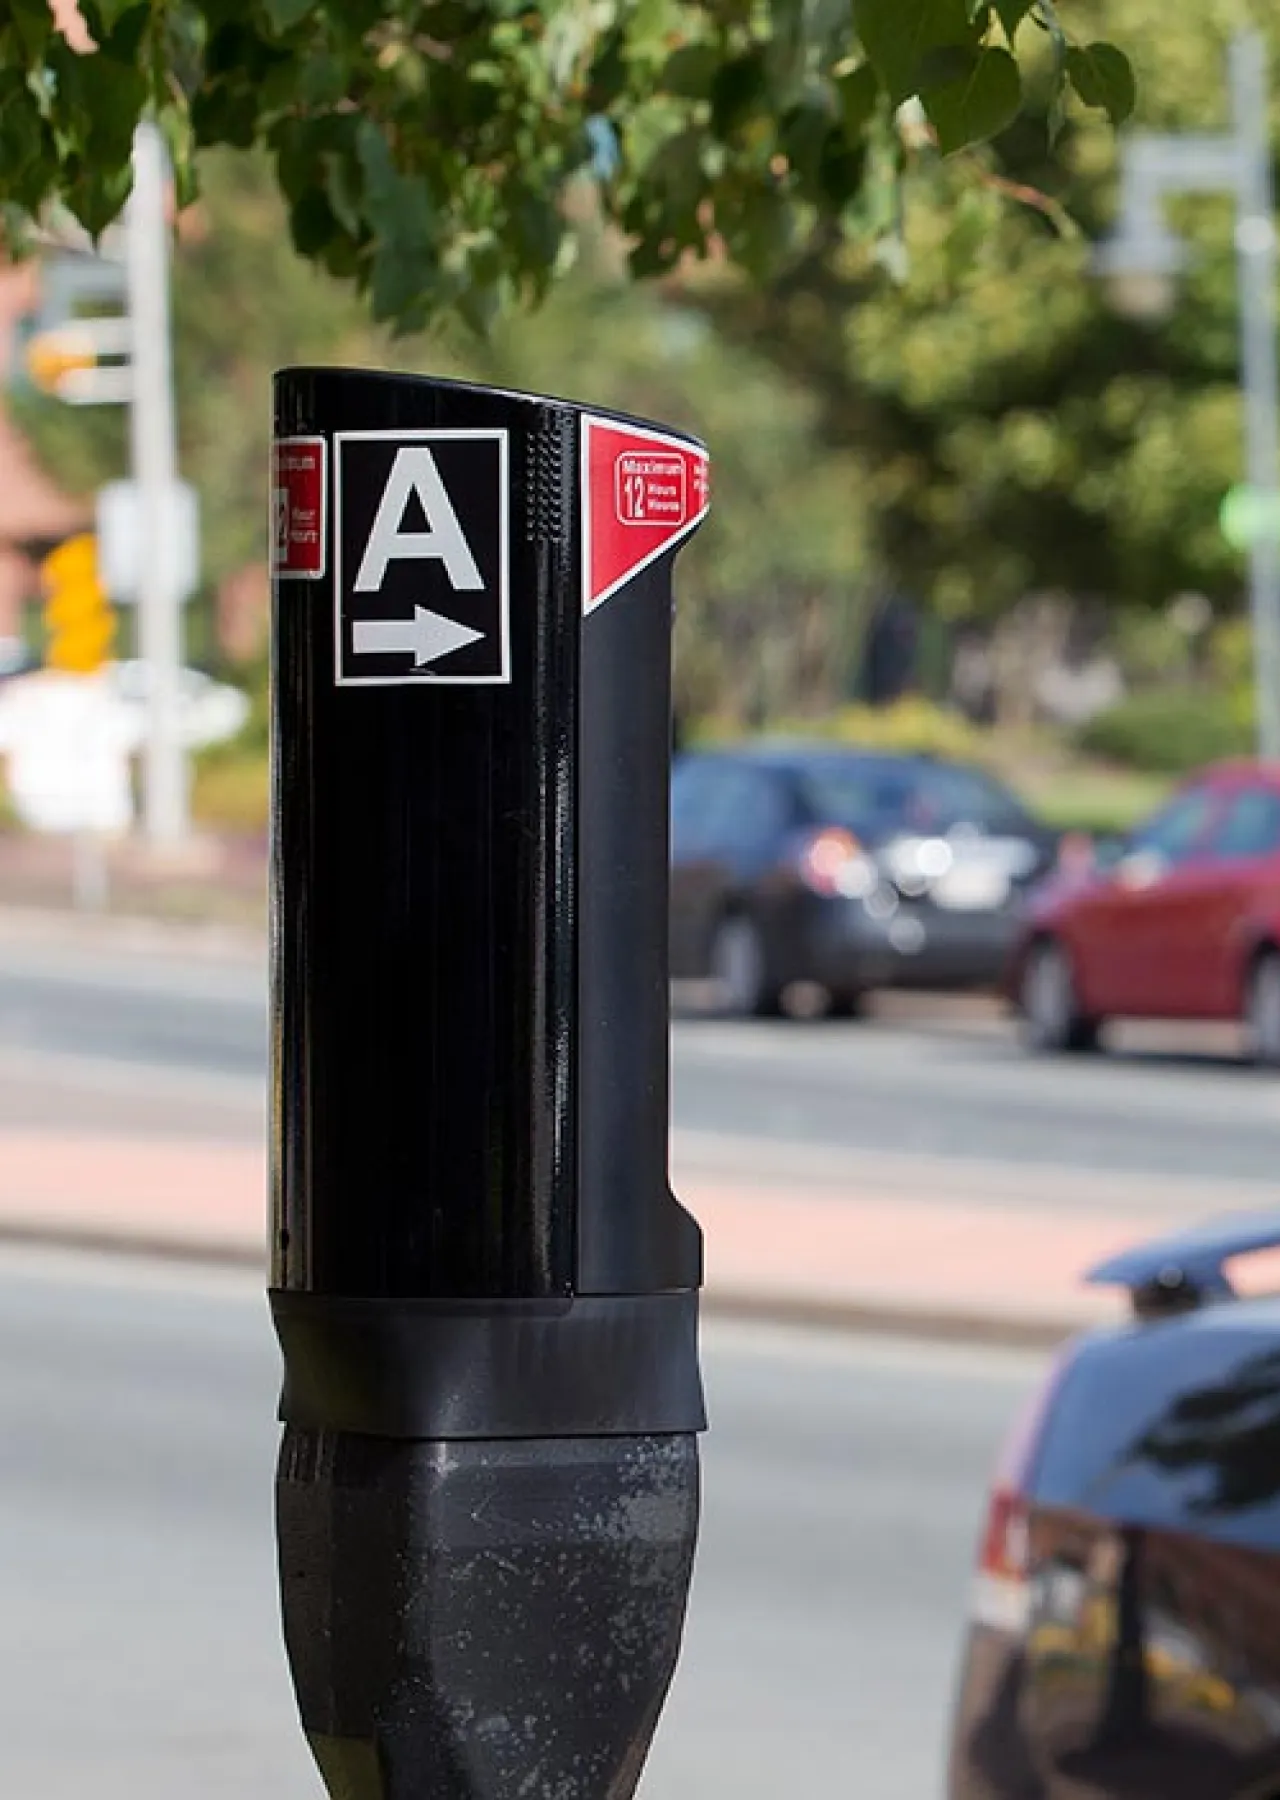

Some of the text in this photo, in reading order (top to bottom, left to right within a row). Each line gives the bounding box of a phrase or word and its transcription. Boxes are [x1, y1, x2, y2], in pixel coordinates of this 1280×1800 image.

[622, 459, 682, 475] Maximum
[624, 475, 646, 518] 12
[352, 446, 486, 592] A
